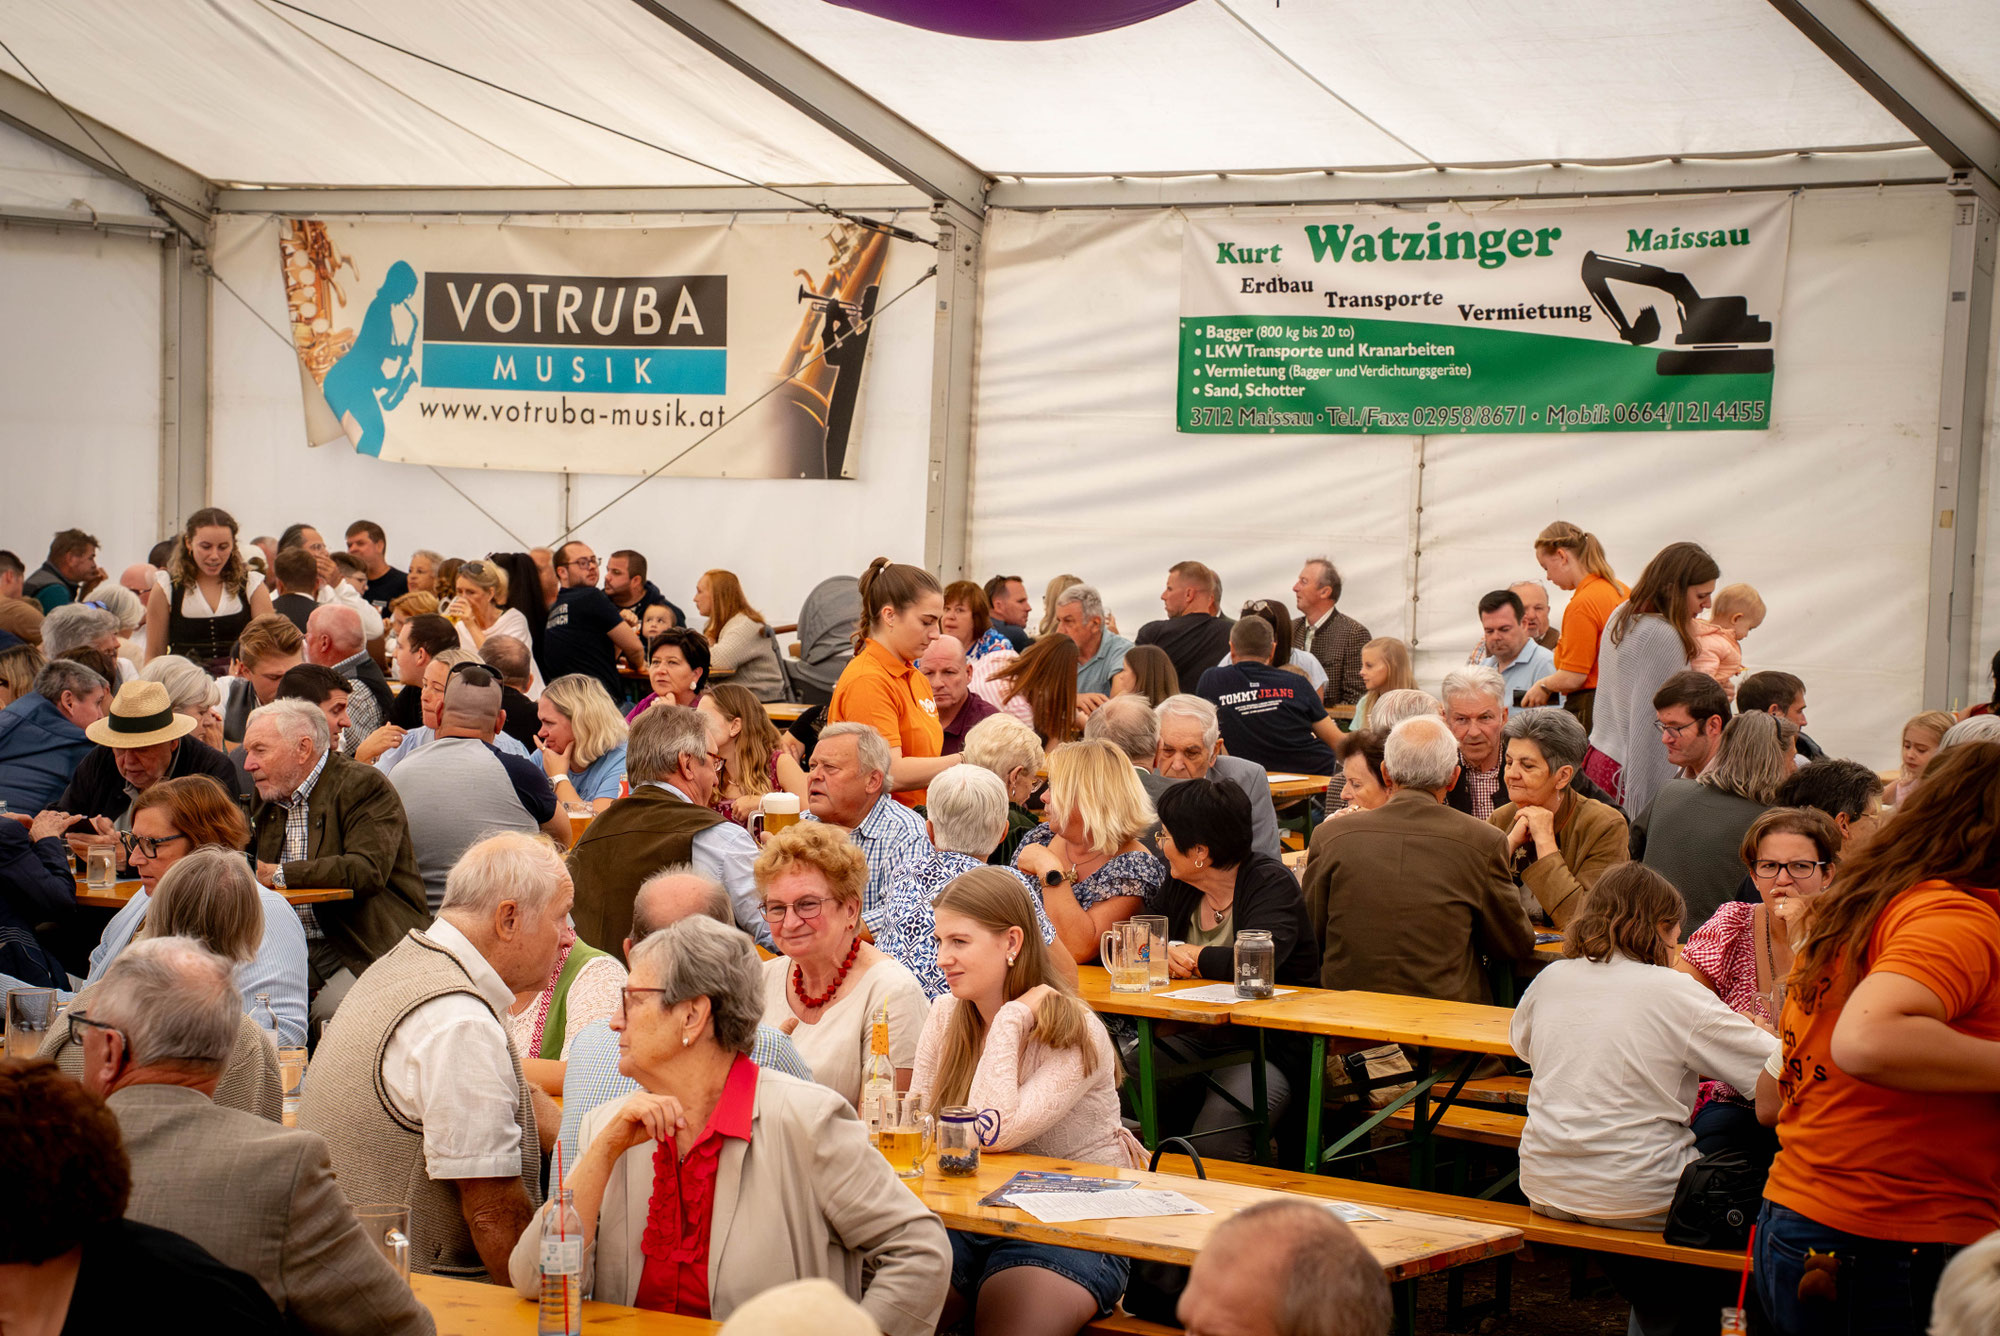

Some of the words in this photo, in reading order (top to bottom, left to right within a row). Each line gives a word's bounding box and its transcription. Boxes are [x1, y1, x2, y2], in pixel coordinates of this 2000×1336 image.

[1304, 221, 1562, 269] Watzinger
[1626, 227, 1750, 252] Maissau
[1216, 242, 1282, 264] Kurt
[1240, 277, 1314, 294] Erdbau
[446, 282, 704, 336] VOTRUBA
[1324, 290, 1443, 311] Transporte
[1458, 303, 1592, 322] Vermietung
[1206, 325, 1253, 342] Bagger
[1256, 326, 1283, 340] (800
[1286, 325, 1299, 341] kg
[1302, 325, 1318, 338] bis
[1321, 325, 1336, 338] 20
[1338, 325, 1355, 339] to)
[1205, 345, 1243, 358] LKW
[1245, 345, 1323, 361] Transporte
[1327, 344, 1354, 358] und
[1358, 342, 1455, 357] Kranarbeiten
[493, 355, 652, 384] MUSIK
[1205, 363, 1286, 381] Vermietung
[1288, 364, 1333, 380] (Bagger
[1336, 363, 1357, 377] und
[1359, 362, 1472, 379] Verdichtungsgeräte)
[1204, 383, 1243, 399] Sand,
[1245, 383, 1305, 397] Schotter
[420, 396, 725, 428] www.votruba-musik.at
[1191, 407, 1232, 426] 3712
[1239, 407, 1313, 426] Maissau
[1326, 406, 1408, 427] Tel./Fax:
[1413, 405, 1525, 426] 02958/8671
[1546, 404, 1609, 426] Mobil:
[1614, 400, 1764, 424] 0664/1214455
